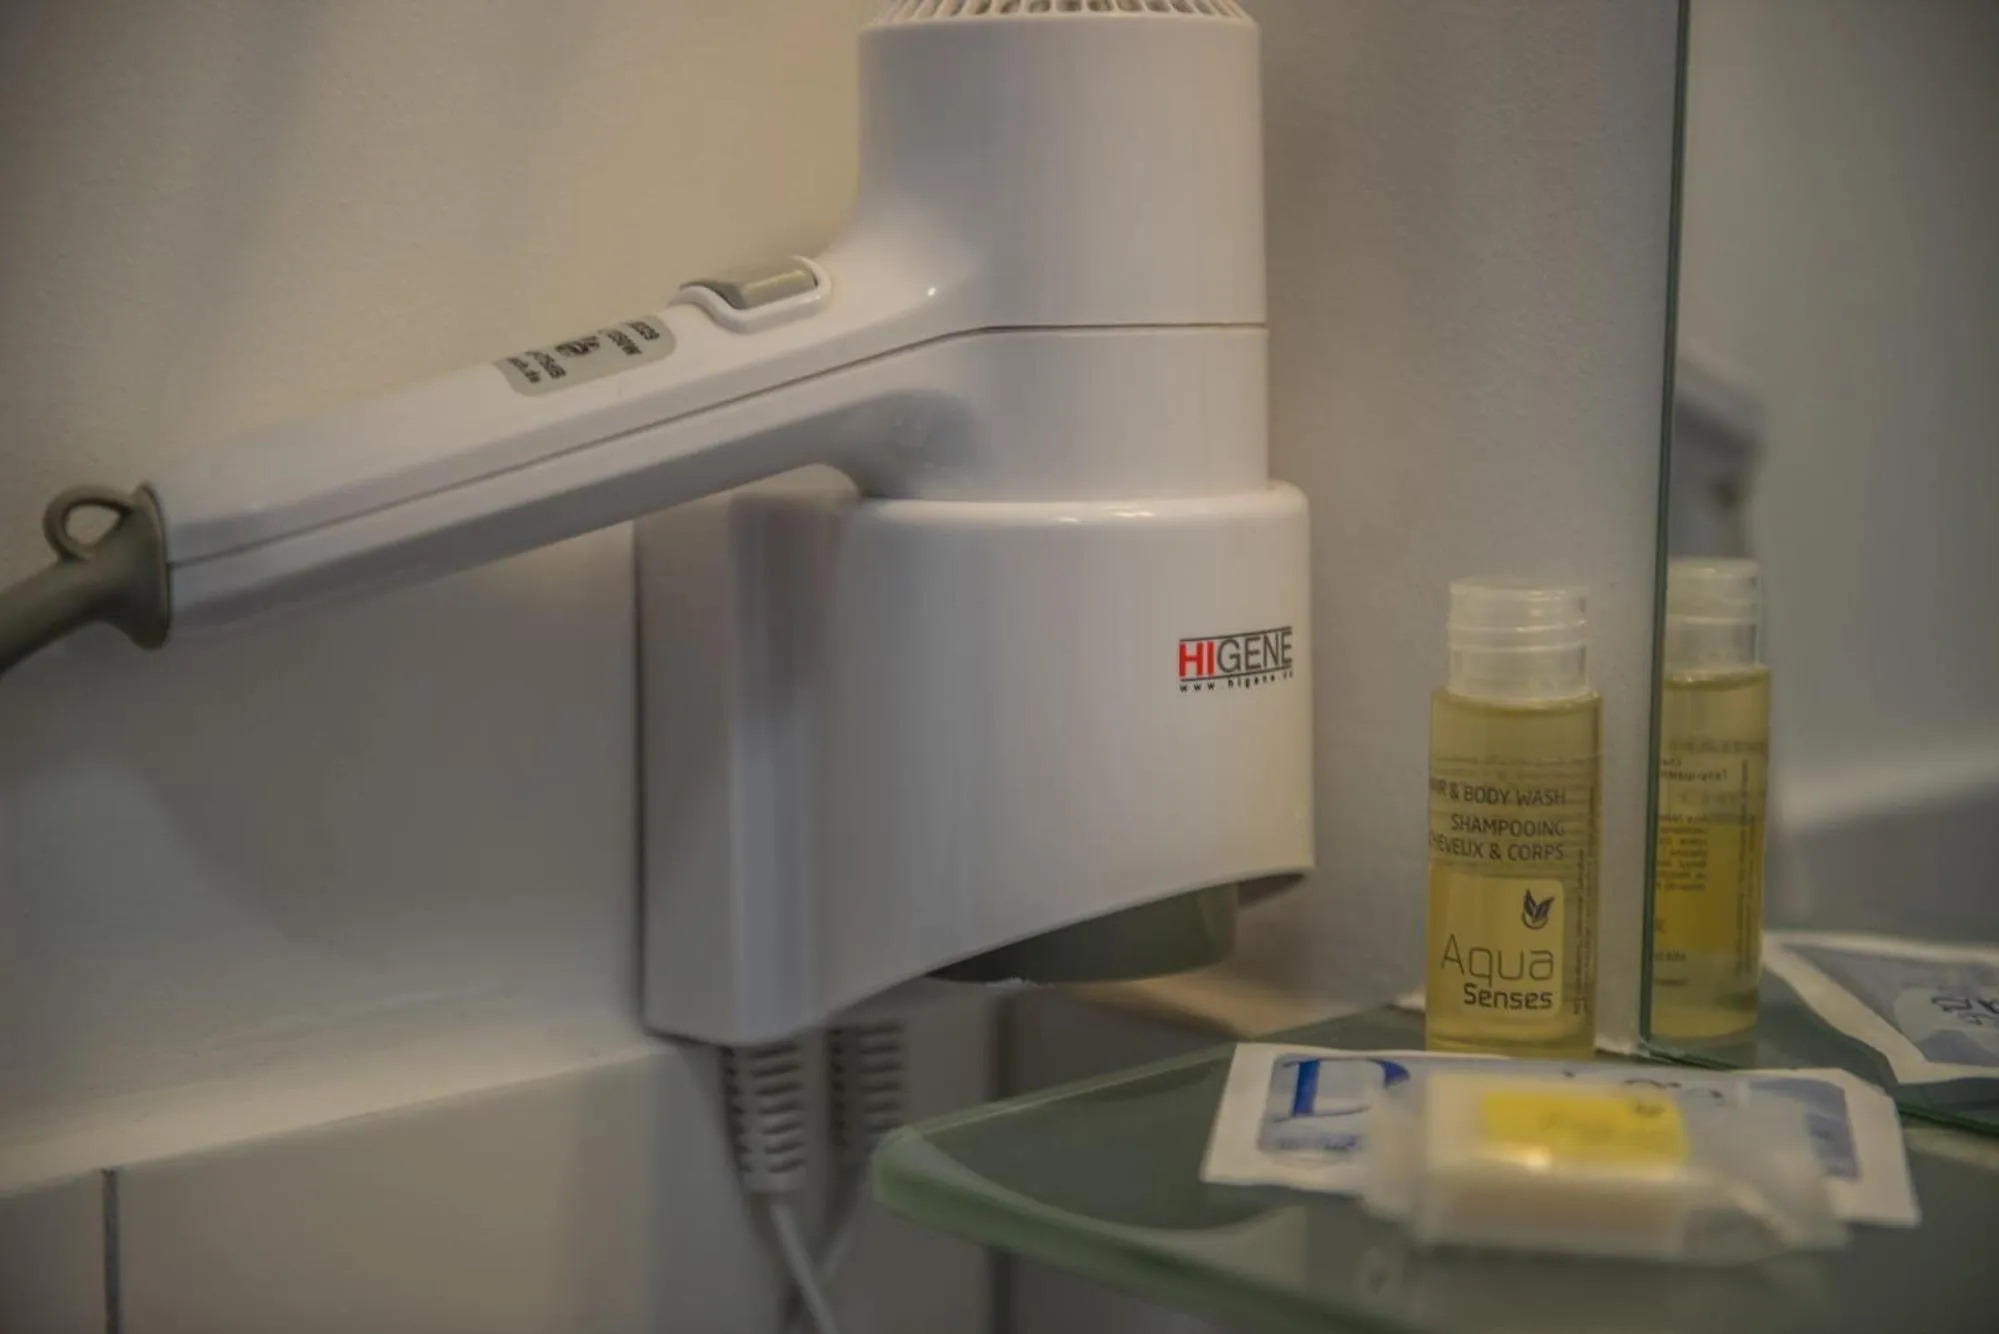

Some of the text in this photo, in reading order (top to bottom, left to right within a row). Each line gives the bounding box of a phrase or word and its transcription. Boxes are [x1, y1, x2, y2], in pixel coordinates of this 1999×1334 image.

[1178, 631, 1293, 678] HIGENE
[1449, 782, 1460, 800] &
[1464, 785, 1511, 806] BODY
[1516, 788, 1567, 806] WASH
[1451, 813, 1565, 837] SHAMPOOING
[1488, 842, 1502, 860] &
[1508, 843, 1564, 861] CORPS
[1441, 934, 1554, 987] Aqua
[1463, 982, 1553, 1010] Senses
